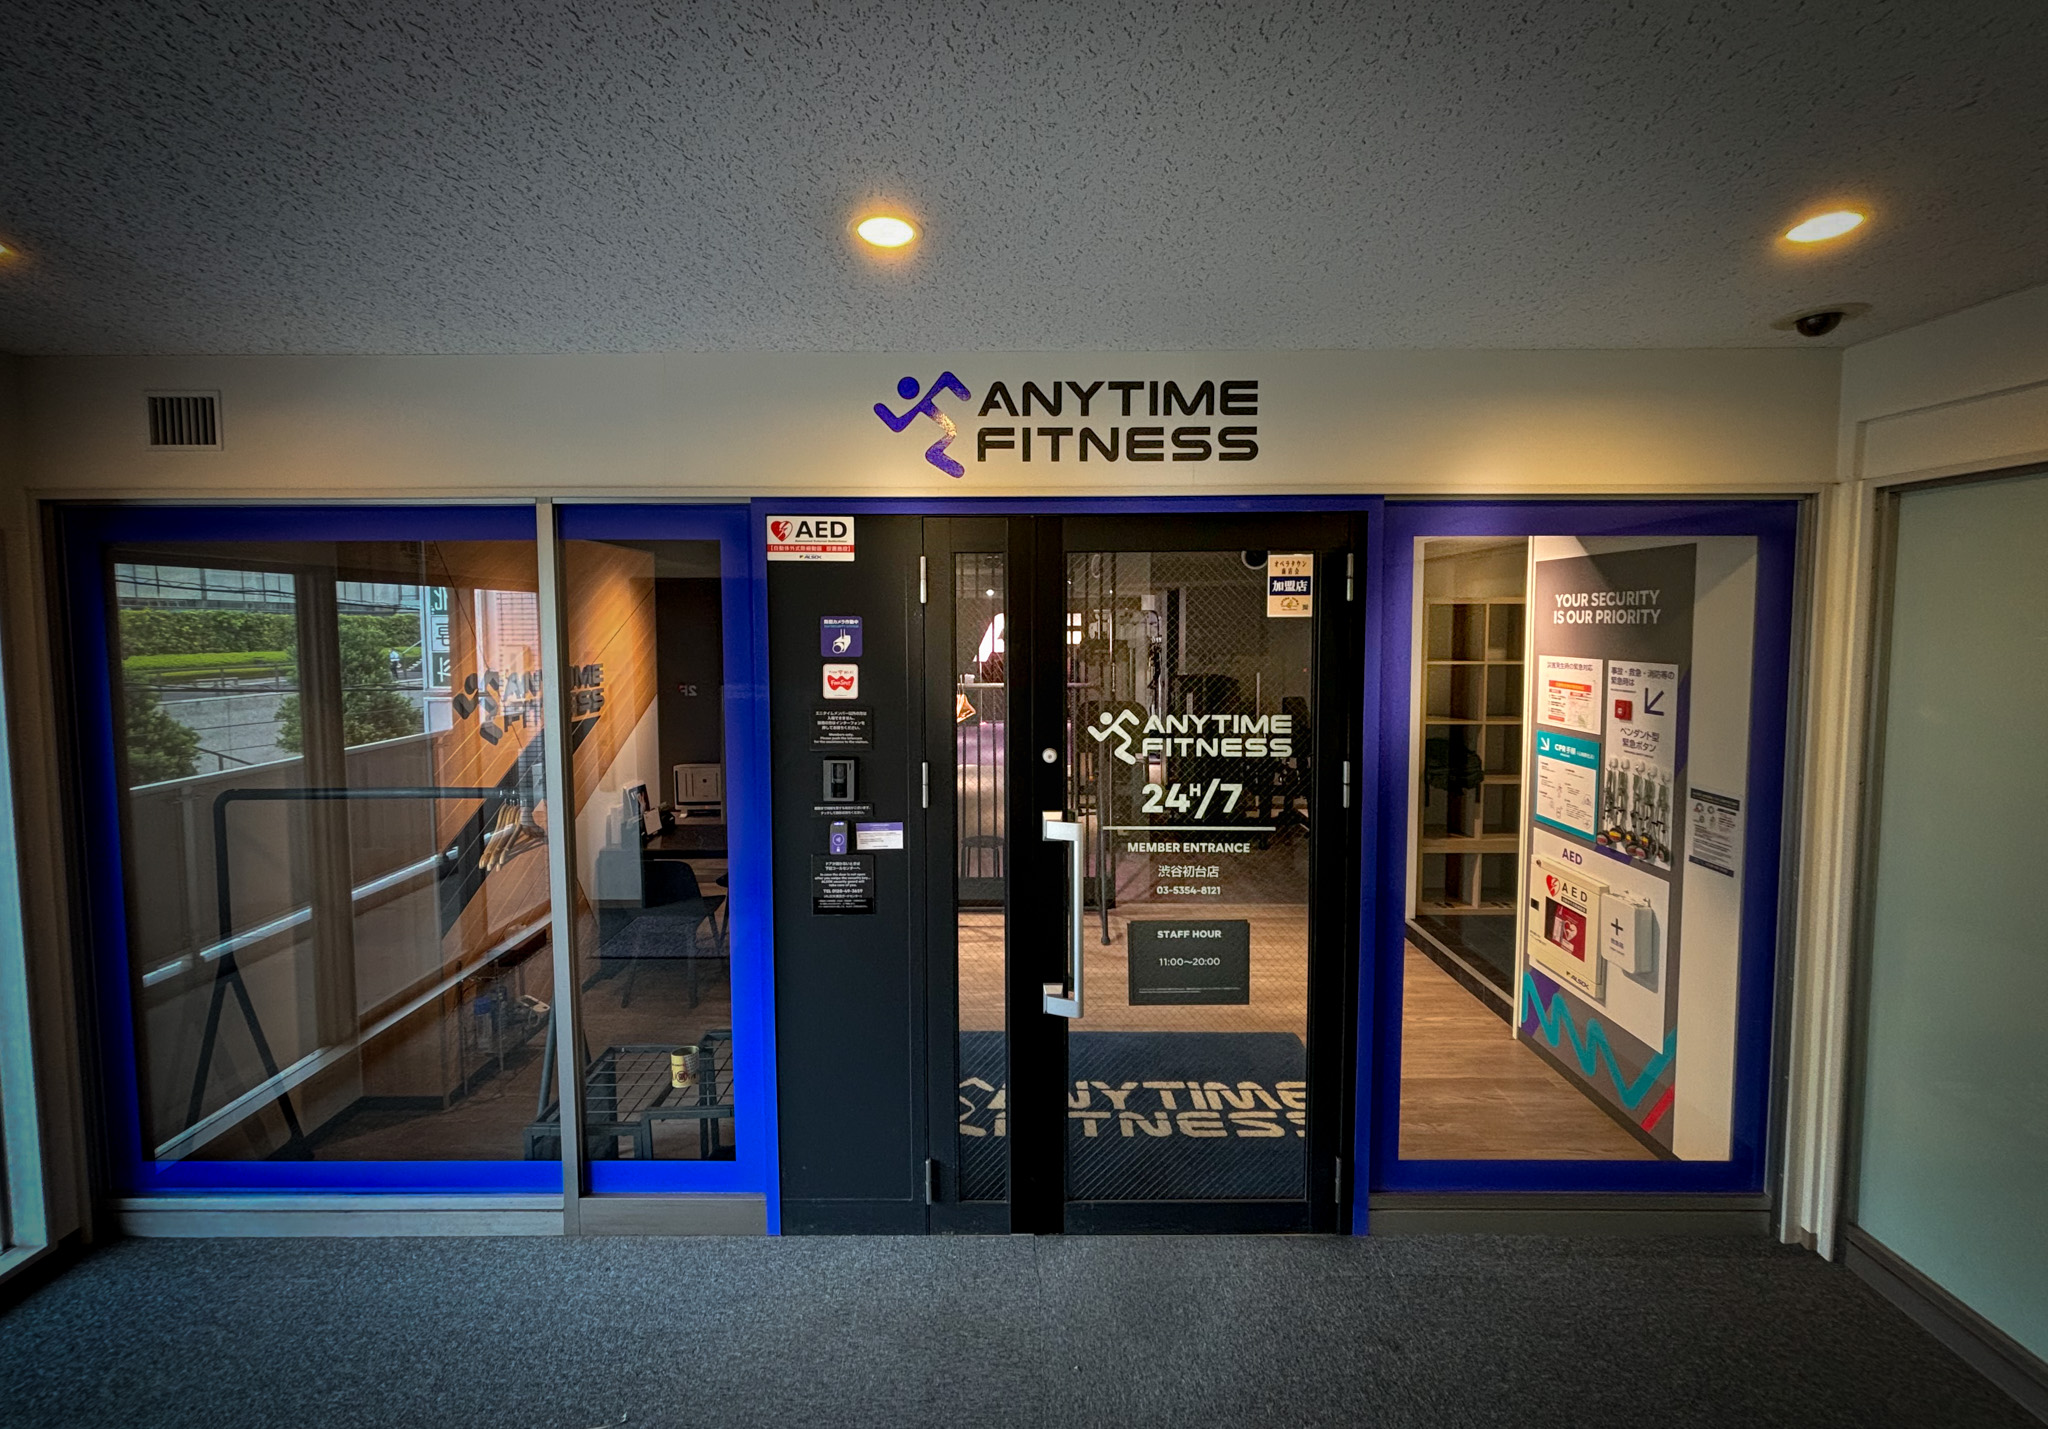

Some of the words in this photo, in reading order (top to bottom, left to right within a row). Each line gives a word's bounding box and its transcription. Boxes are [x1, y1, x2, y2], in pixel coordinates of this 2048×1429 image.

[977, 380, 1259, 416] ANYTIME
[977, 427, 1259, 462] FITNESS
[795, 521, 847, 538] AED
[1272, 580, 1308, 592] 加盟店
[1555, 593, 1589, 608] YOUR
[1591, 590, 1661, 606] SECURITY
[1554, 610, 1565, 624] IS
[1566, 610, 1593, 624] OUR
[1596, 608, 1661, 624] PRIORITY
[1143, 714, 1292, 734] ANYTIME
[1143, 738, 1292, 757] FITNESS
[1142, 778, 1242, 819] 24H/7
[1128, 843, 1180, 853] MEMBER
[1183, 843, 1250, 853] ENTRANCE
[1562, 848, 1583, 865] AED
[1158, 866, 1219, 878] 渋谷初台店
[1156, 886, 1220, 895] 03-5354-8121
[1562, 882, 1588, 902] AED
[1157, 930, 1190, 938] STAFF
[1192, 930, 1222, 938] HOUR
